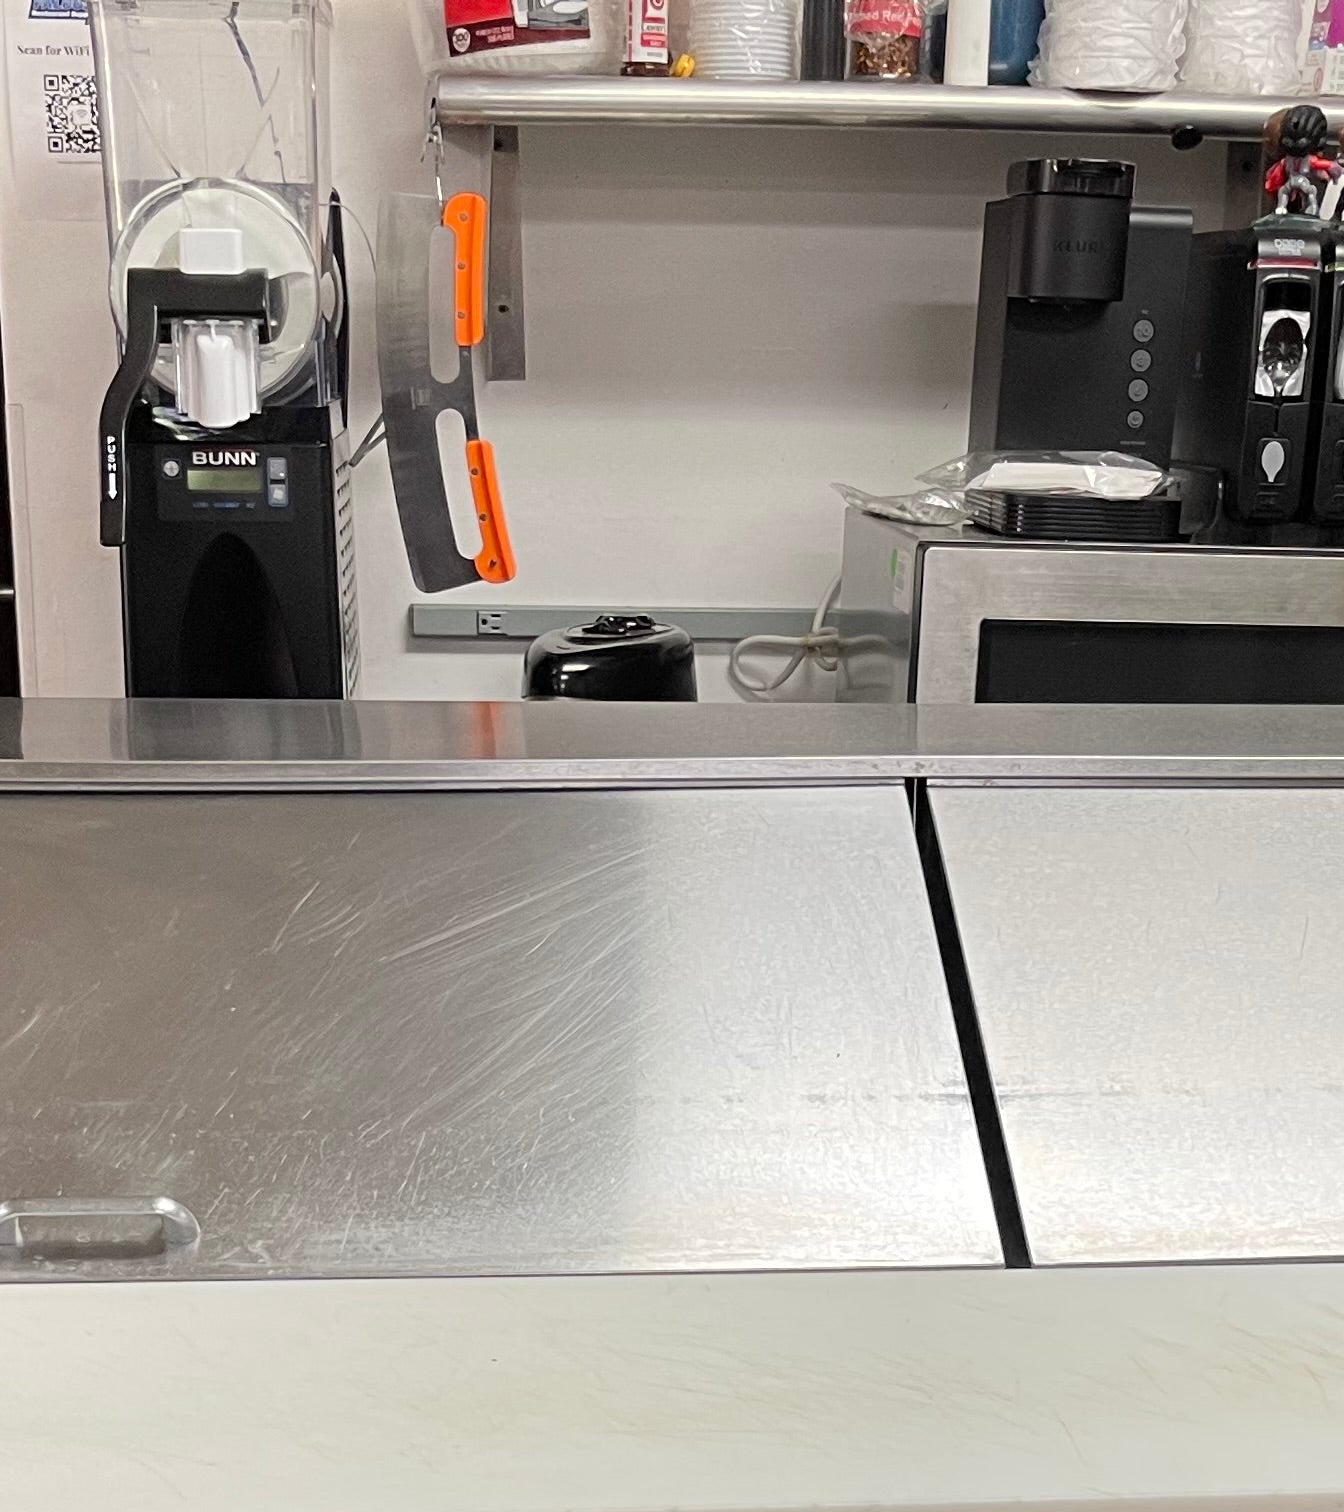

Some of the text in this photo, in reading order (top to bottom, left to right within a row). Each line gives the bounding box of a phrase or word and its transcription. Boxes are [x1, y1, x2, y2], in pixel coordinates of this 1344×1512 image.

[17, 45, 43, 55] Scan
[45, 45, 62, 56] for
[106, 436, 117, 472] PUSH
[192, 451, 257, 466] BUNN
